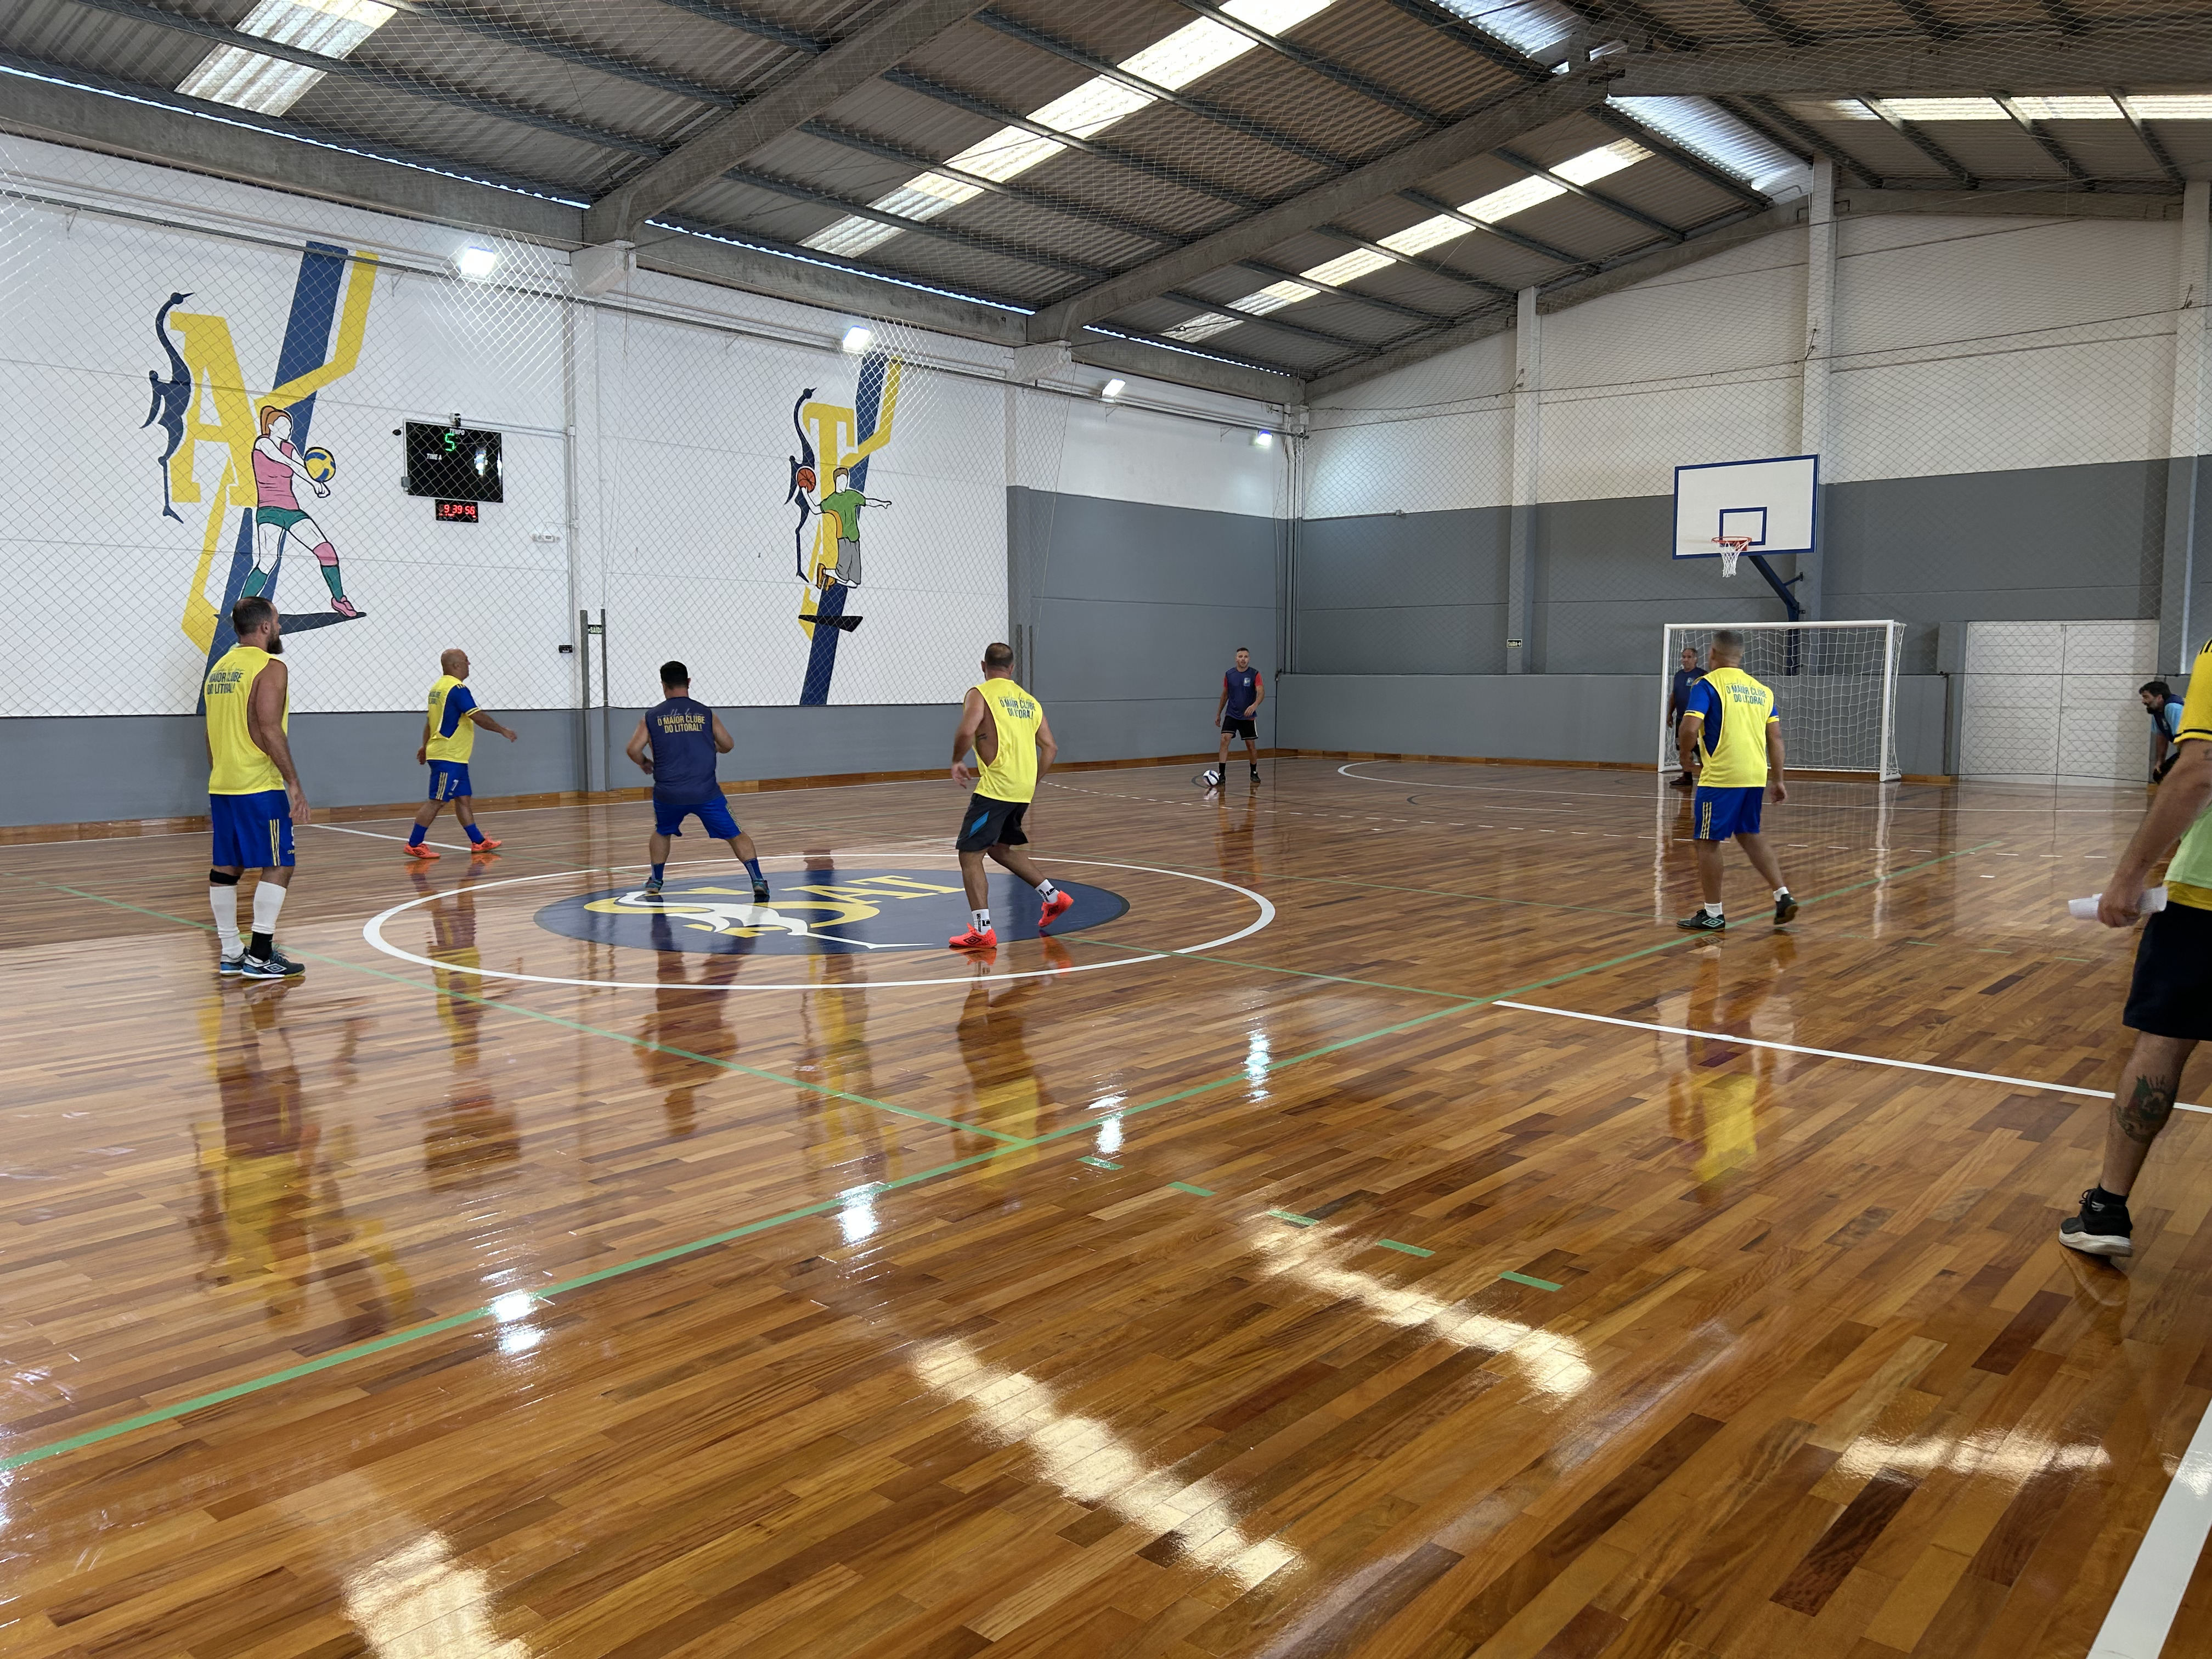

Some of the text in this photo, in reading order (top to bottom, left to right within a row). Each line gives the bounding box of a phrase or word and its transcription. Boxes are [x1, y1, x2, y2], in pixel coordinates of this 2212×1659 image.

[445, 433, 455, 452] 5
[1726, 686, 1731, 694] O
[1734, 694, 1741, 702] DO
[1000, 699, 1005, 708] O
[657, 715, 706, 726] O MAIOR CLUBE
[664, 725, 674, 733] DO
